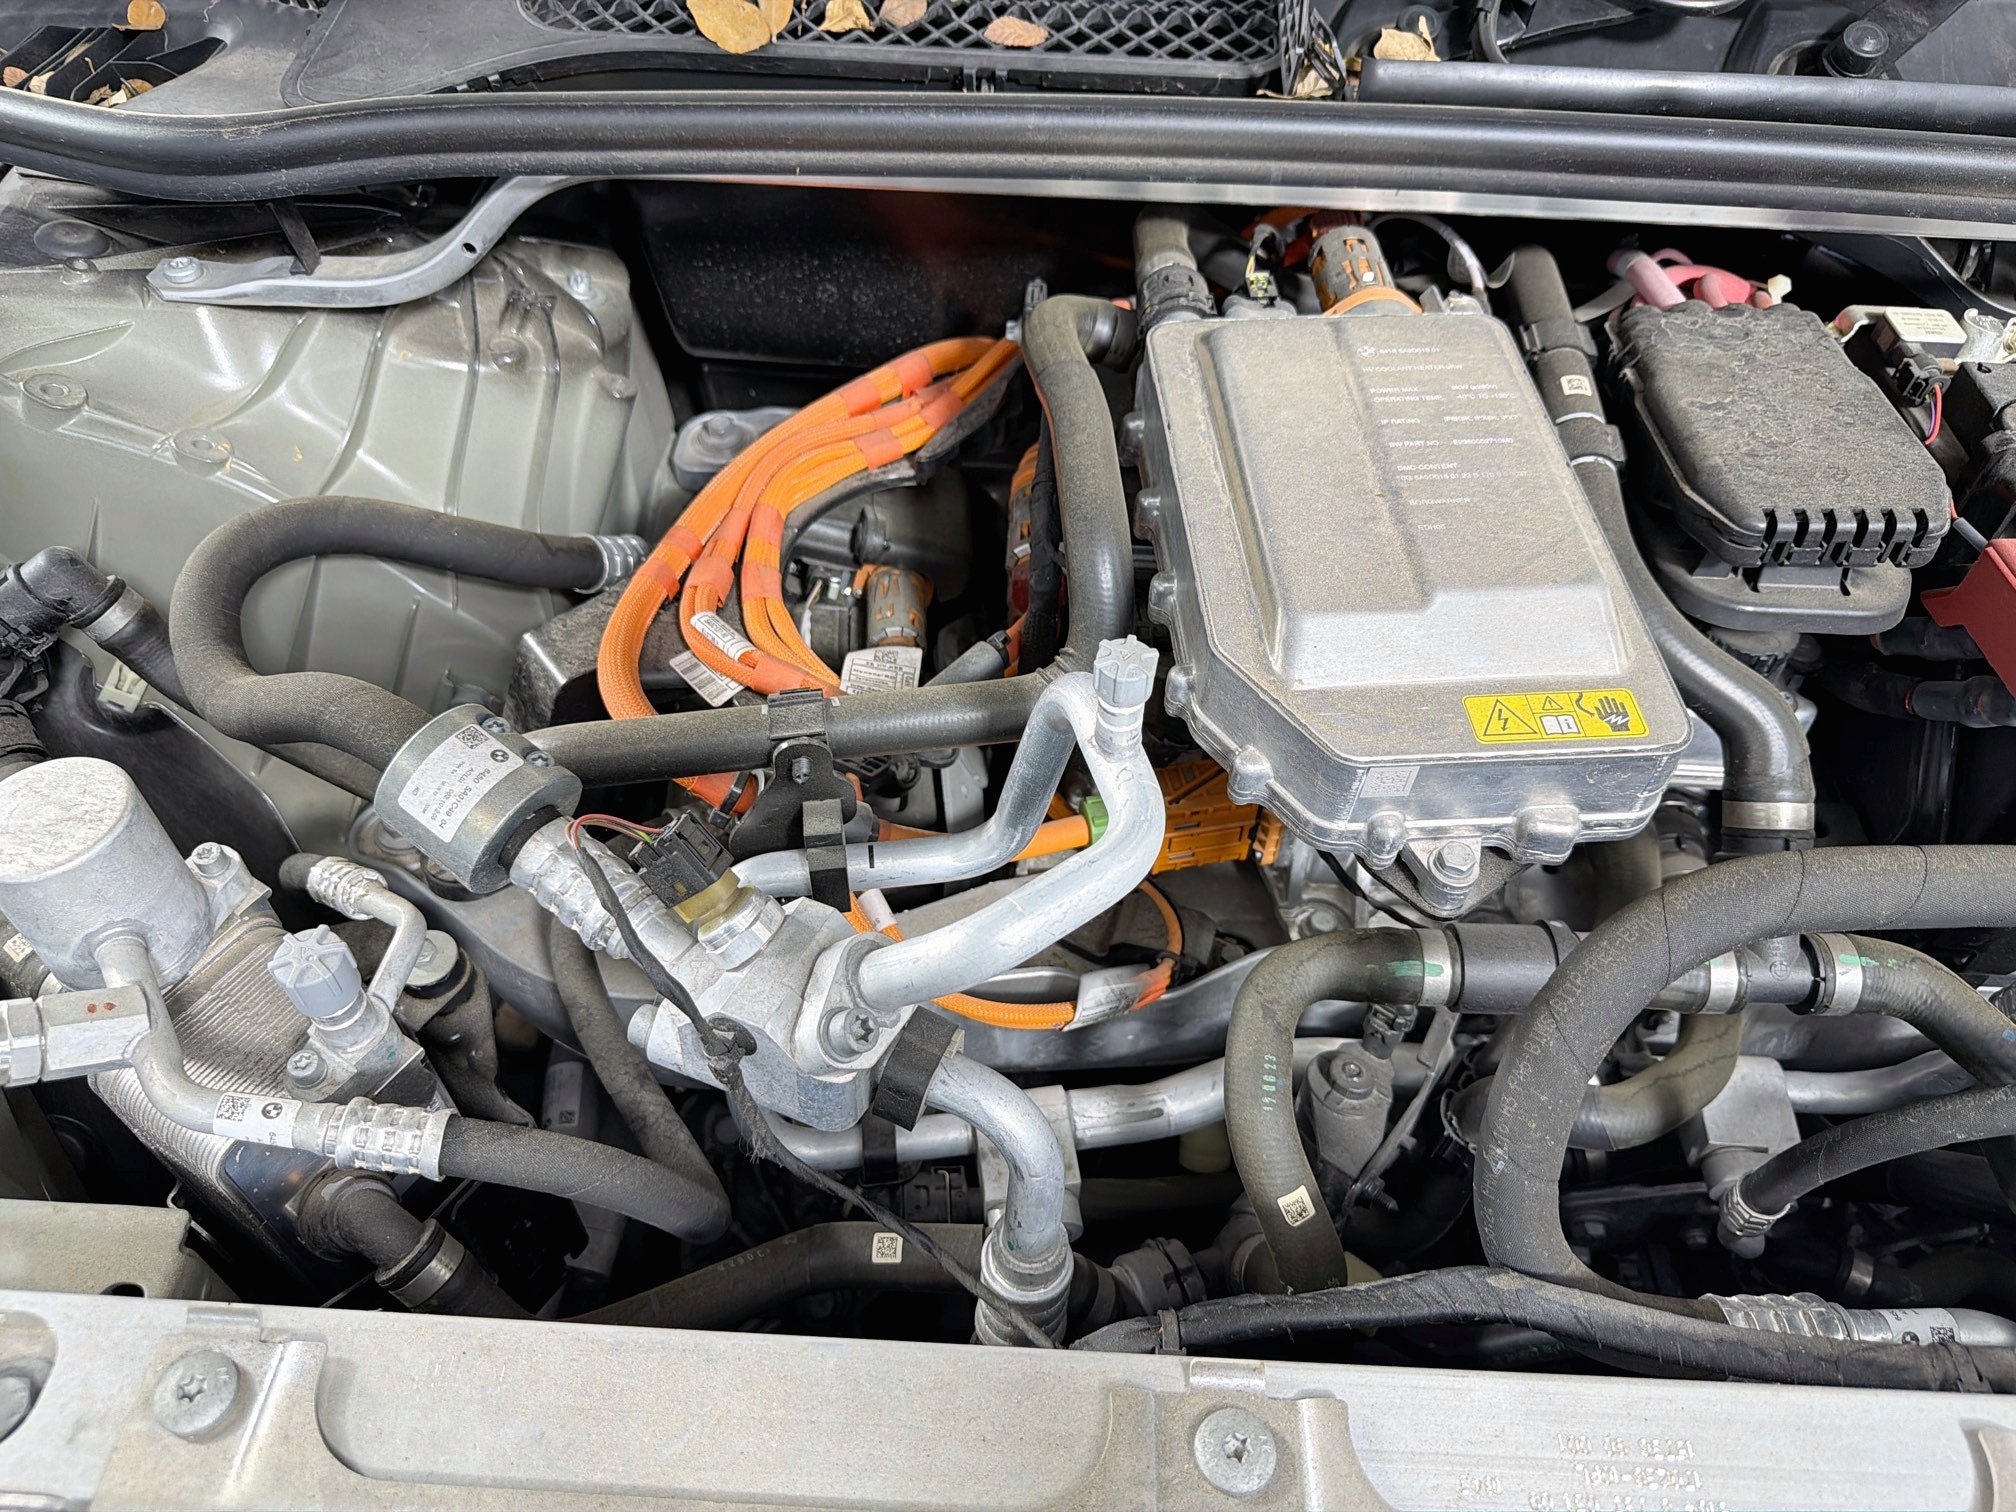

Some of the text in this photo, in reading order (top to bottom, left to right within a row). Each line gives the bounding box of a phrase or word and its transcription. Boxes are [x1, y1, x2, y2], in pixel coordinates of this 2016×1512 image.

[1397, 462, 1458, 471] DMC-CONTENT
[1409, 497, 1471, 506] BORGWARNER
[472, 767, 491, 784] 6450
